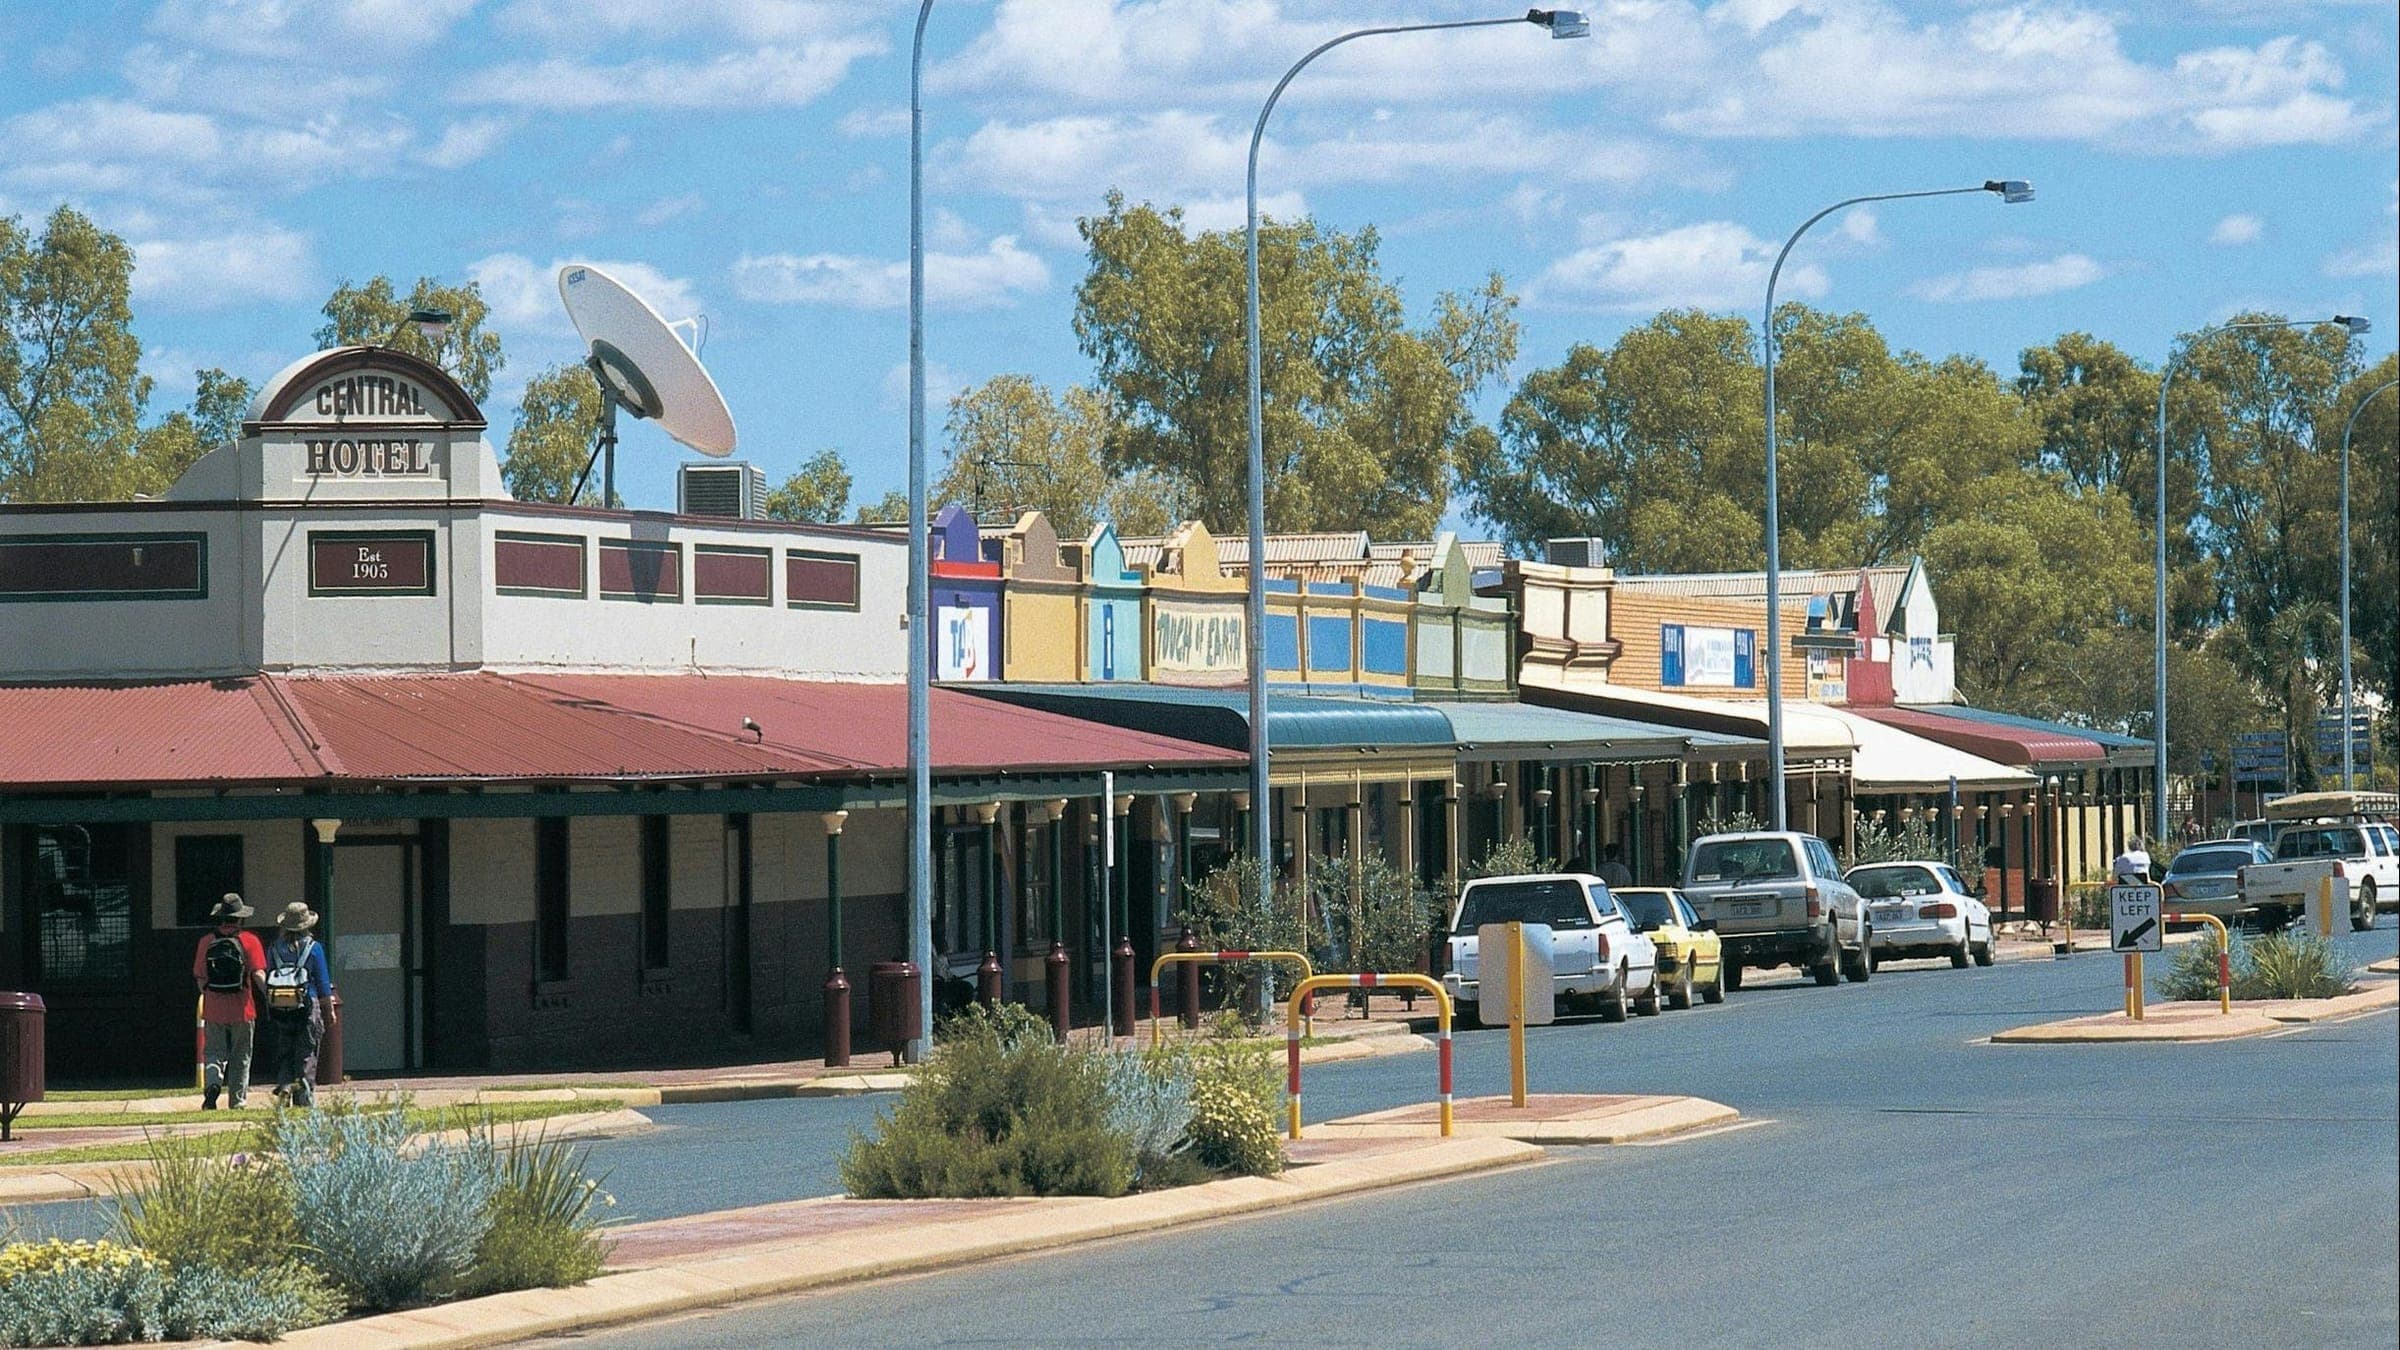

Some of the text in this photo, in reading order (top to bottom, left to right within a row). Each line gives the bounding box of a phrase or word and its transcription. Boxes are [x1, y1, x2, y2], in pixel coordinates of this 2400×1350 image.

[316, 375, 426, 416] CENTRAL
[305, 438, 430, 474] HOTEL
[358, 547, 382, 562] Est
[352, 562, 389, 579] 1905
[1156, 611, 1193, 666] TOUCH
[1206, 615, 1242, 667] EARTH
[2119, 891, 2152, 902] KEEP
[2120, 905, 2150, 916] LEFT
